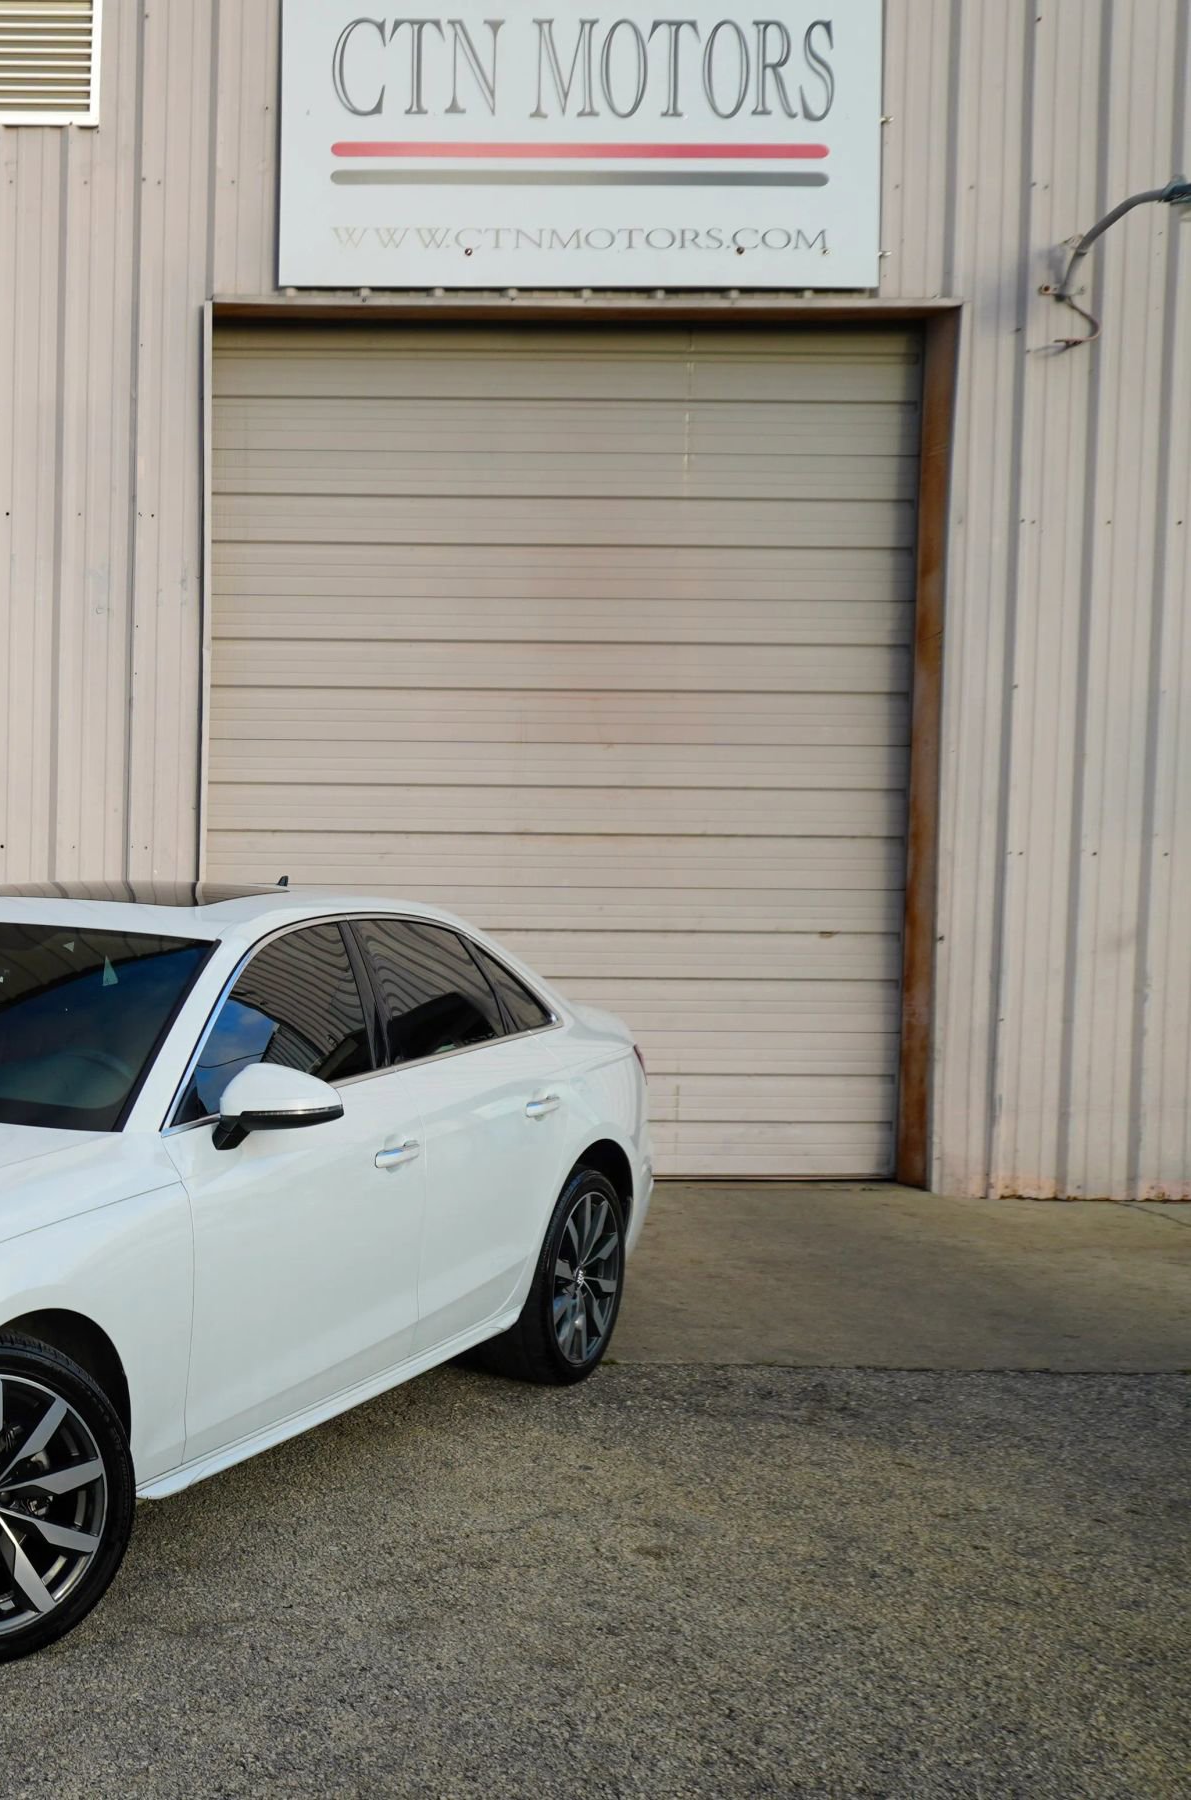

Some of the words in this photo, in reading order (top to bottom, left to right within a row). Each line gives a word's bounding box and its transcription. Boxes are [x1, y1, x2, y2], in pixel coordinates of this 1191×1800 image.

[331, 17, 506, 117] CTN
[528, 17, 836, 122] MOTORS
[330, 226, 828, 251] WWW.CTNMOTORS.COM
